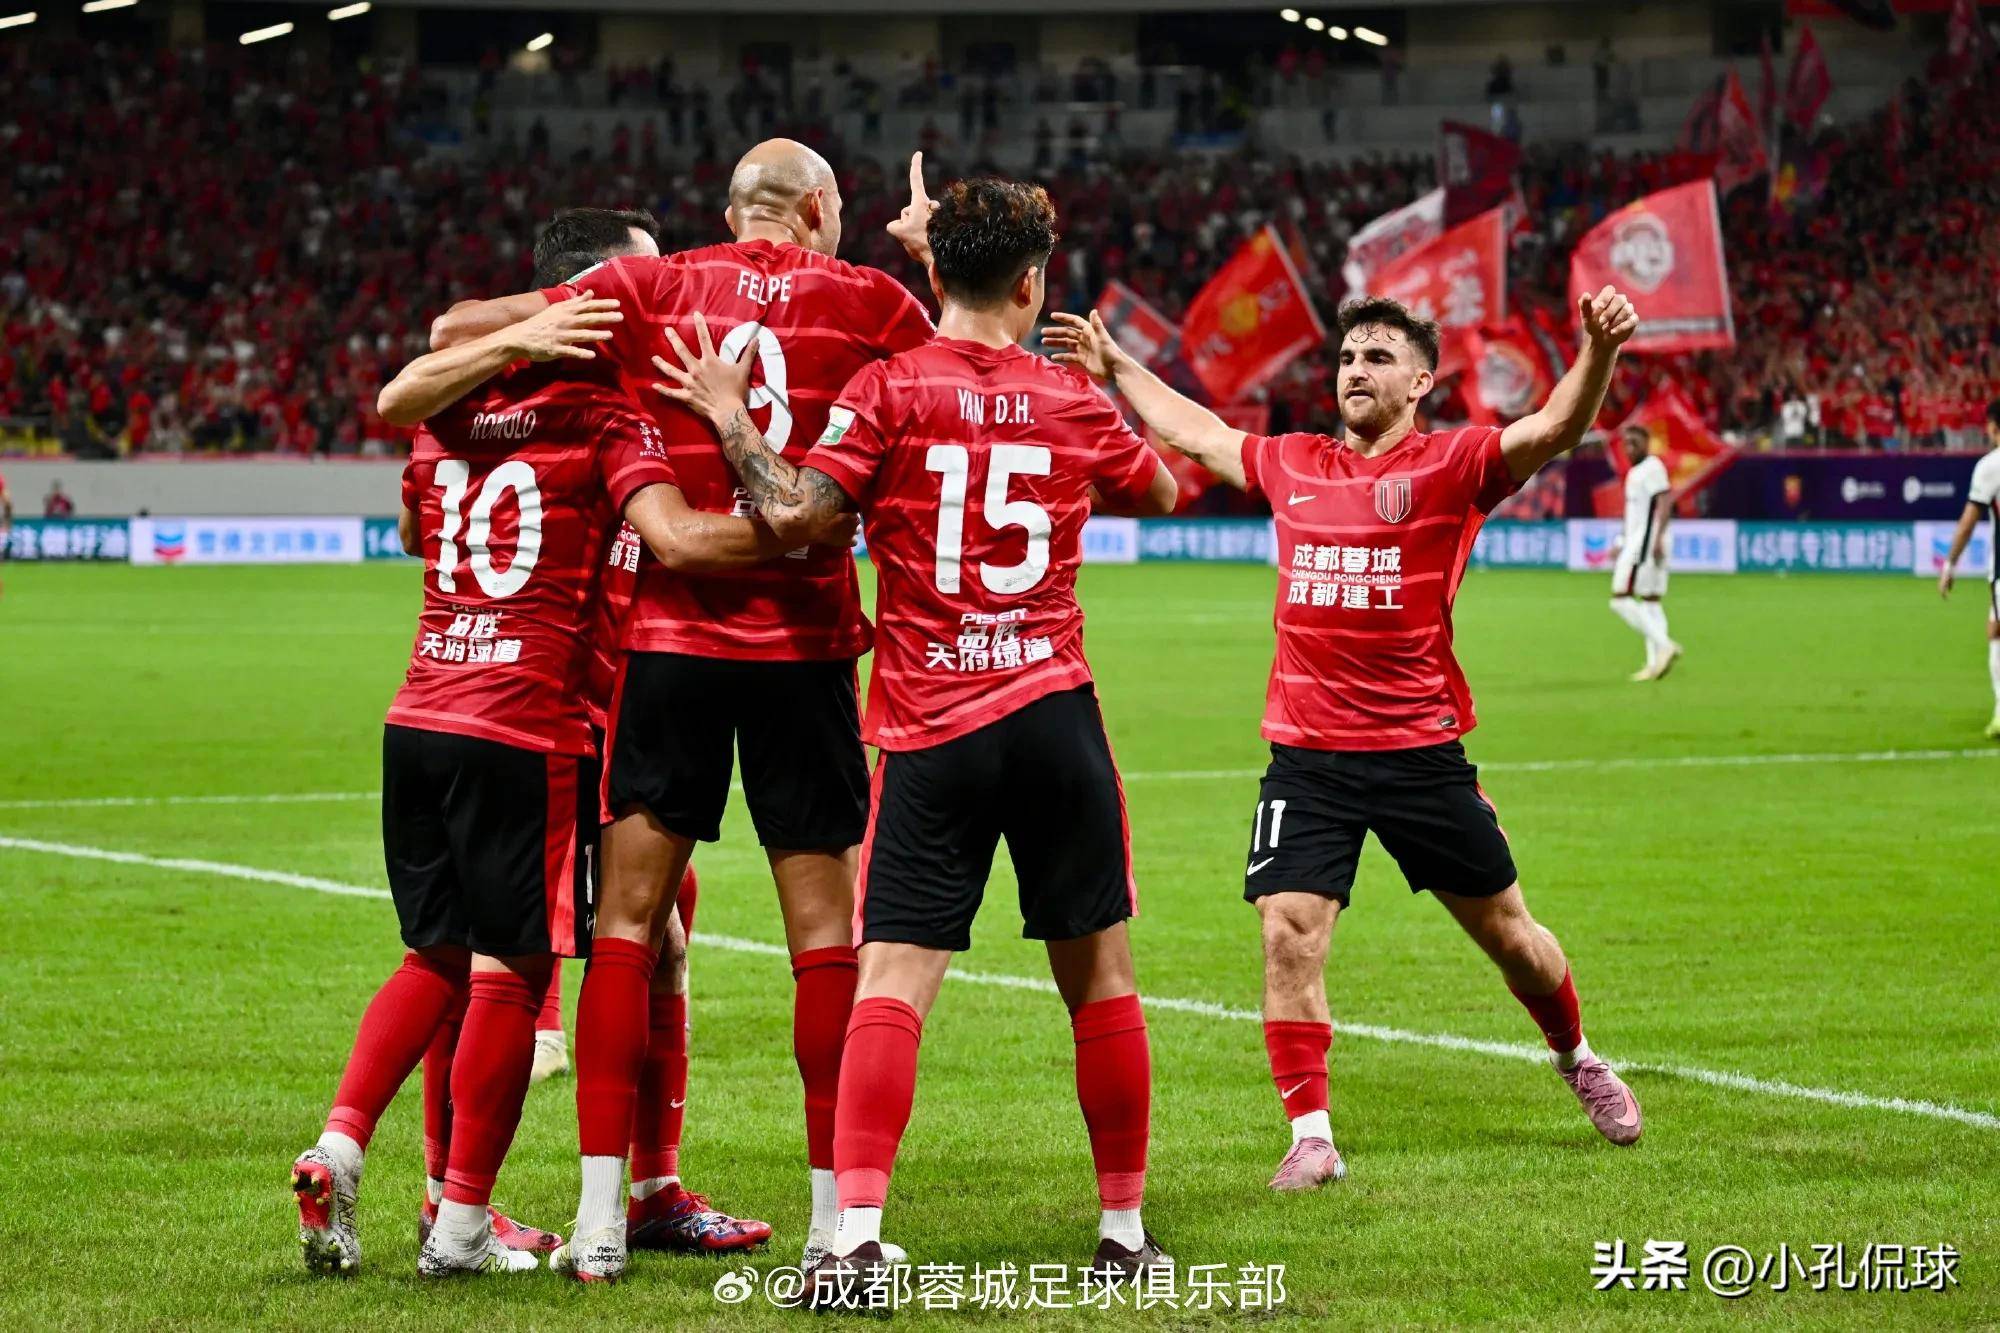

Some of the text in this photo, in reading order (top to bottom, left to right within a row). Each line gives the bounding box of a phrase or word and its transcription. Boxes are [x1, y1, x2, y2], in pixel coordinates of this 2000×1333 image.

[719, 320, 793, 455] 9
[958, 388, 1035, 425] YAN D.H.
[470, 410, 537, 440] ROMULO
[433, 459, 543, 599] 10
[925, 444, 1052, 595] 15
[1292, 543, 1402, 573] 成都蓉城
[1291, 569, 1402, 584] CHENGDU RONGCHENG
[1287, 581, 1404, 610] 成都建工
[444, 613, 501, 638] 品胜
[957, 622, 1020, 650] 品胜
[419, 632, 523, 663] 天府绿道
[925, 636, 1054, 672] 天府绿道
[1254, 800, 1287, 852] 11
[587, 1253, 625, 1264] balance
[597, 1245, 619, 1253] new
